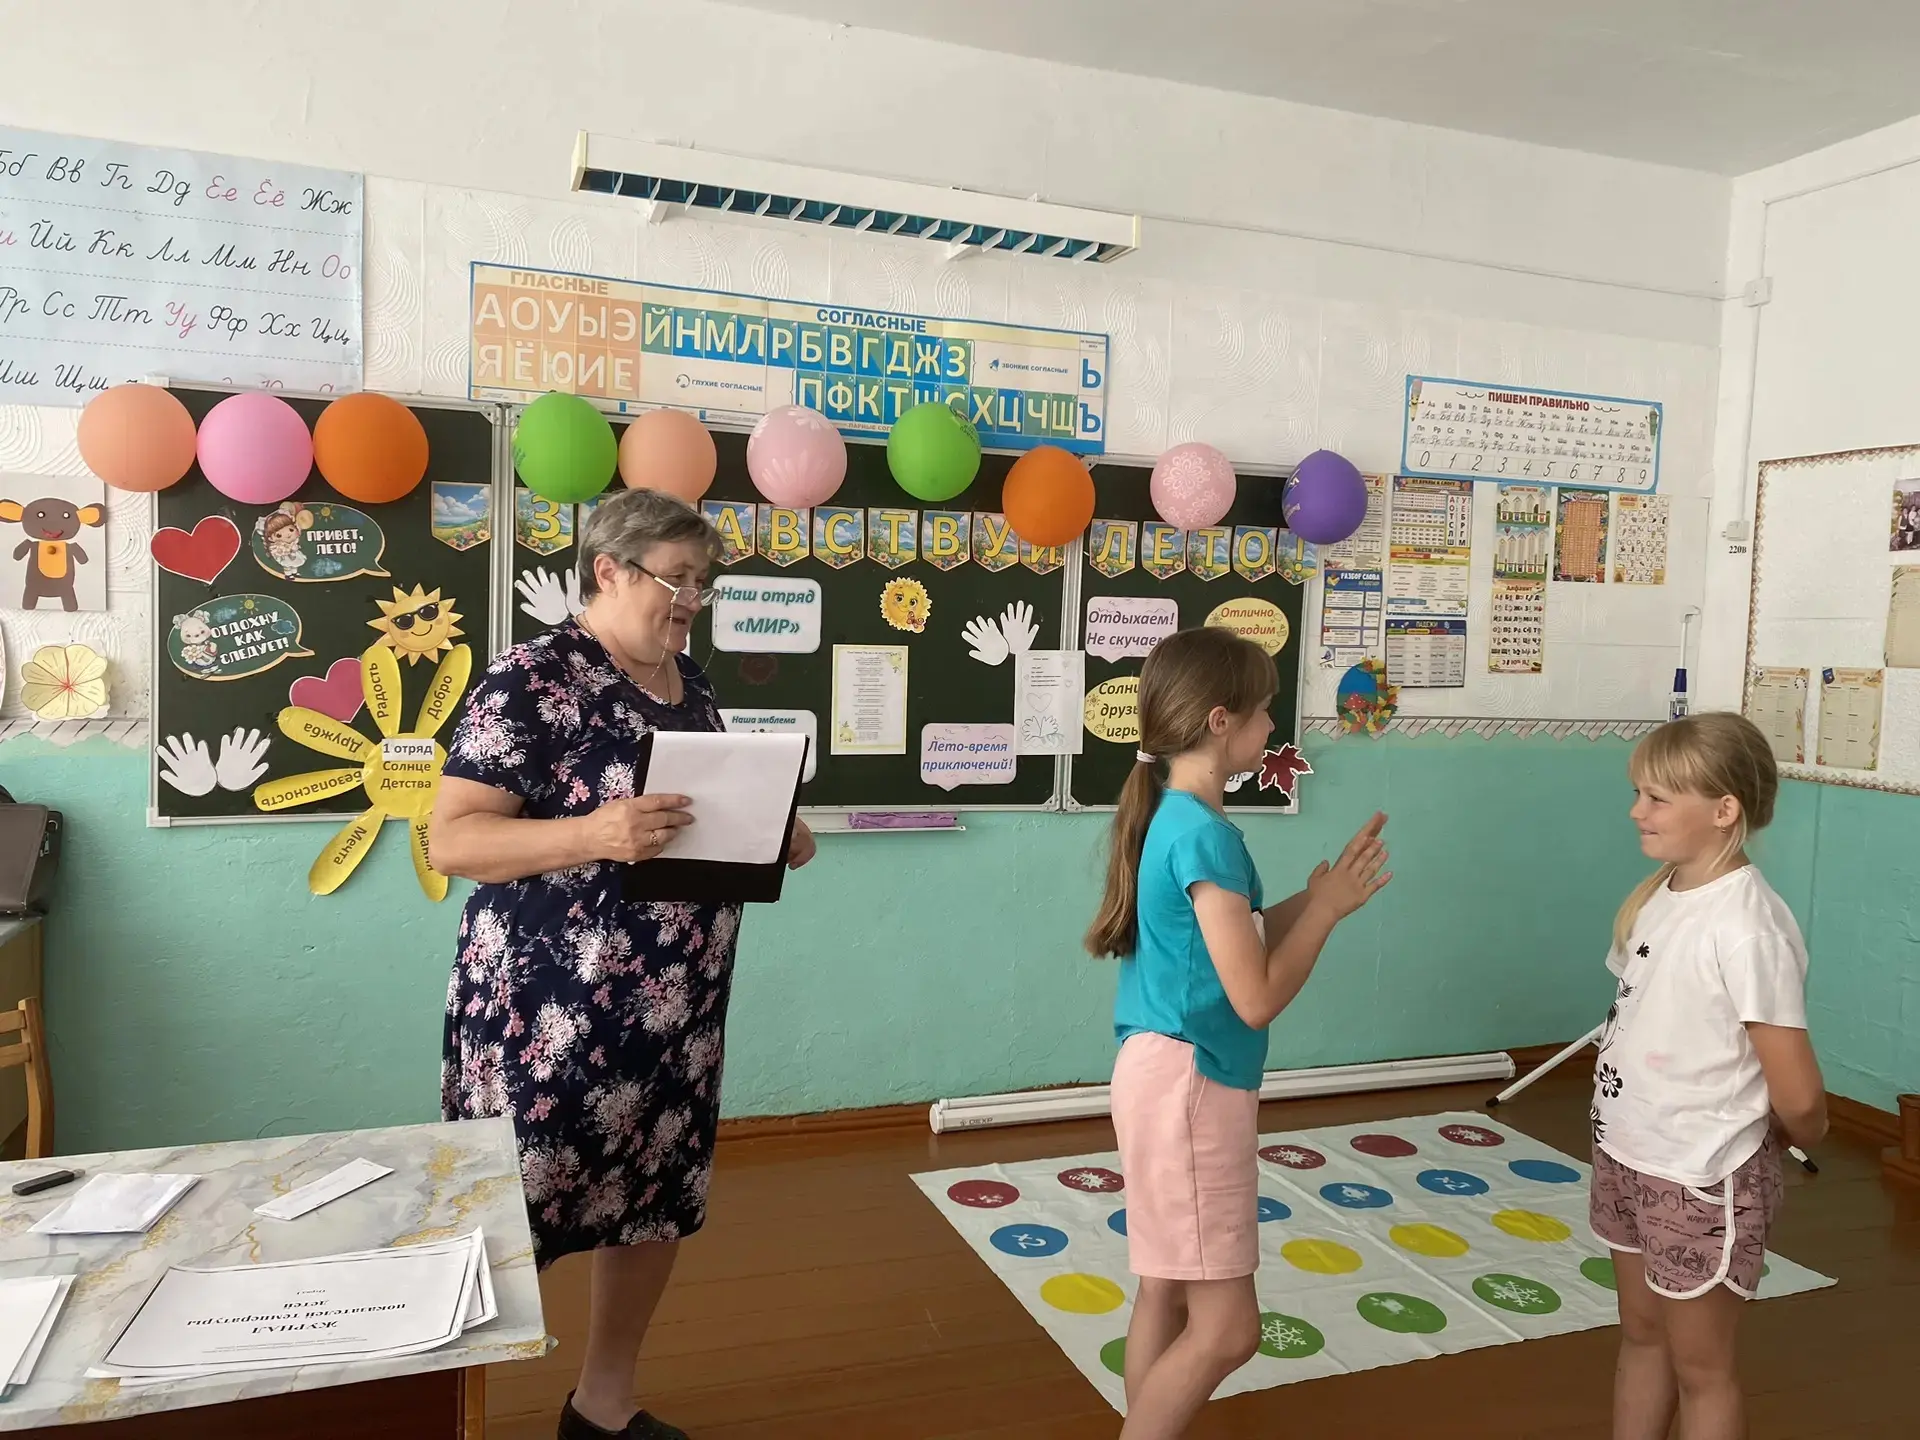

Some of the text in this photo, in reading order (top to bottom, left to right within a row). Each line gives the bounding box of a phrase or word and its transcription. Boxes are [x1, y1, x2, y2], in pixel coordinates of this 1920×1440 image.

[46, 156, 86, 184] Вв
[100, 162, 134, 190] Гг
[146, 169, 192, 207] Дд
[205, 174, 239, 202] Ее
[253, 178, 286, 207] Ёё
[300, 187, 353, 215] Жж
[29, 218, 76, 252] Йй
[88, 229, 135, 259] Кк
[146, 237, 191, 264] Лл
[201, 242, 257, 271] Мм
[267, 249, 312, 276] Нн
[321, 253, 352, 280] Оо
[509, 271, 609, 296] ГЛАСНЫЕ
[42, 290, 76, 319] Сс
[87, 294, 153, 325] Тт
[165, 301, 198, 340] Уу
[207, 304, 249, 342] Фф
[258, 312, 302, 339] Хх
[311, 316, 351, 346] Цц
[816, 309, 927, 333] СОГЛАСНЫЕ
[1001, 363, 1069, 375] ЗВОНКИЕ СОГЛАСНЫЕ
[691, 379, 763, 393] ГЛУХИЕ СОГЛАСНЫЕ
[1488, 391, 1590, 412] ПИШЕМ ПРАВИЛЬНО
[1419, 450, 1647, 485] 0 1 2 3 4 5 6 7 8 9
[306, 529, 364, 543] ПРИВЕТ,
[316, 542, 357, 555] ЛЕТО!
[719, 586, 815, 606] Наш отряд
[1088, 610, 1175, 626] Отдыхаем!
[1221, 607, 1274, 618] Отлично
[211, 611, 279, 639] ОТДОХНУ
[733, 618, 800, 634] «МИР»
[235, 629, 266, 647] КАК
[1087, 632, 1106, 645] Не
[219, 637, 290, 666] СЛЕДУЕТ!
[369, 662, 389, 719] Радость
[427, 675, 453, 720] Добро
[731, 715, 797, 725] Наша эмблема
[303, 721, 364, 754] Дружба
[383, 743, 433, 757] 1 отряд
[928, 740, 1008, 754] Лето-время
[383, 761, 432, 774] Солнце
[922, 758, 1013, 772] приключений!
[261, 770, 364, 808] Безопасность
[380, 778, 432, 790] Детства
[334, 825, 368, 867] Мечта
[283, 1300, 330, 1310] детей
[187, 1303, 406, 1326] показателей температуры
[252, 1321, 337, 1334] ЖУРНАЛ
